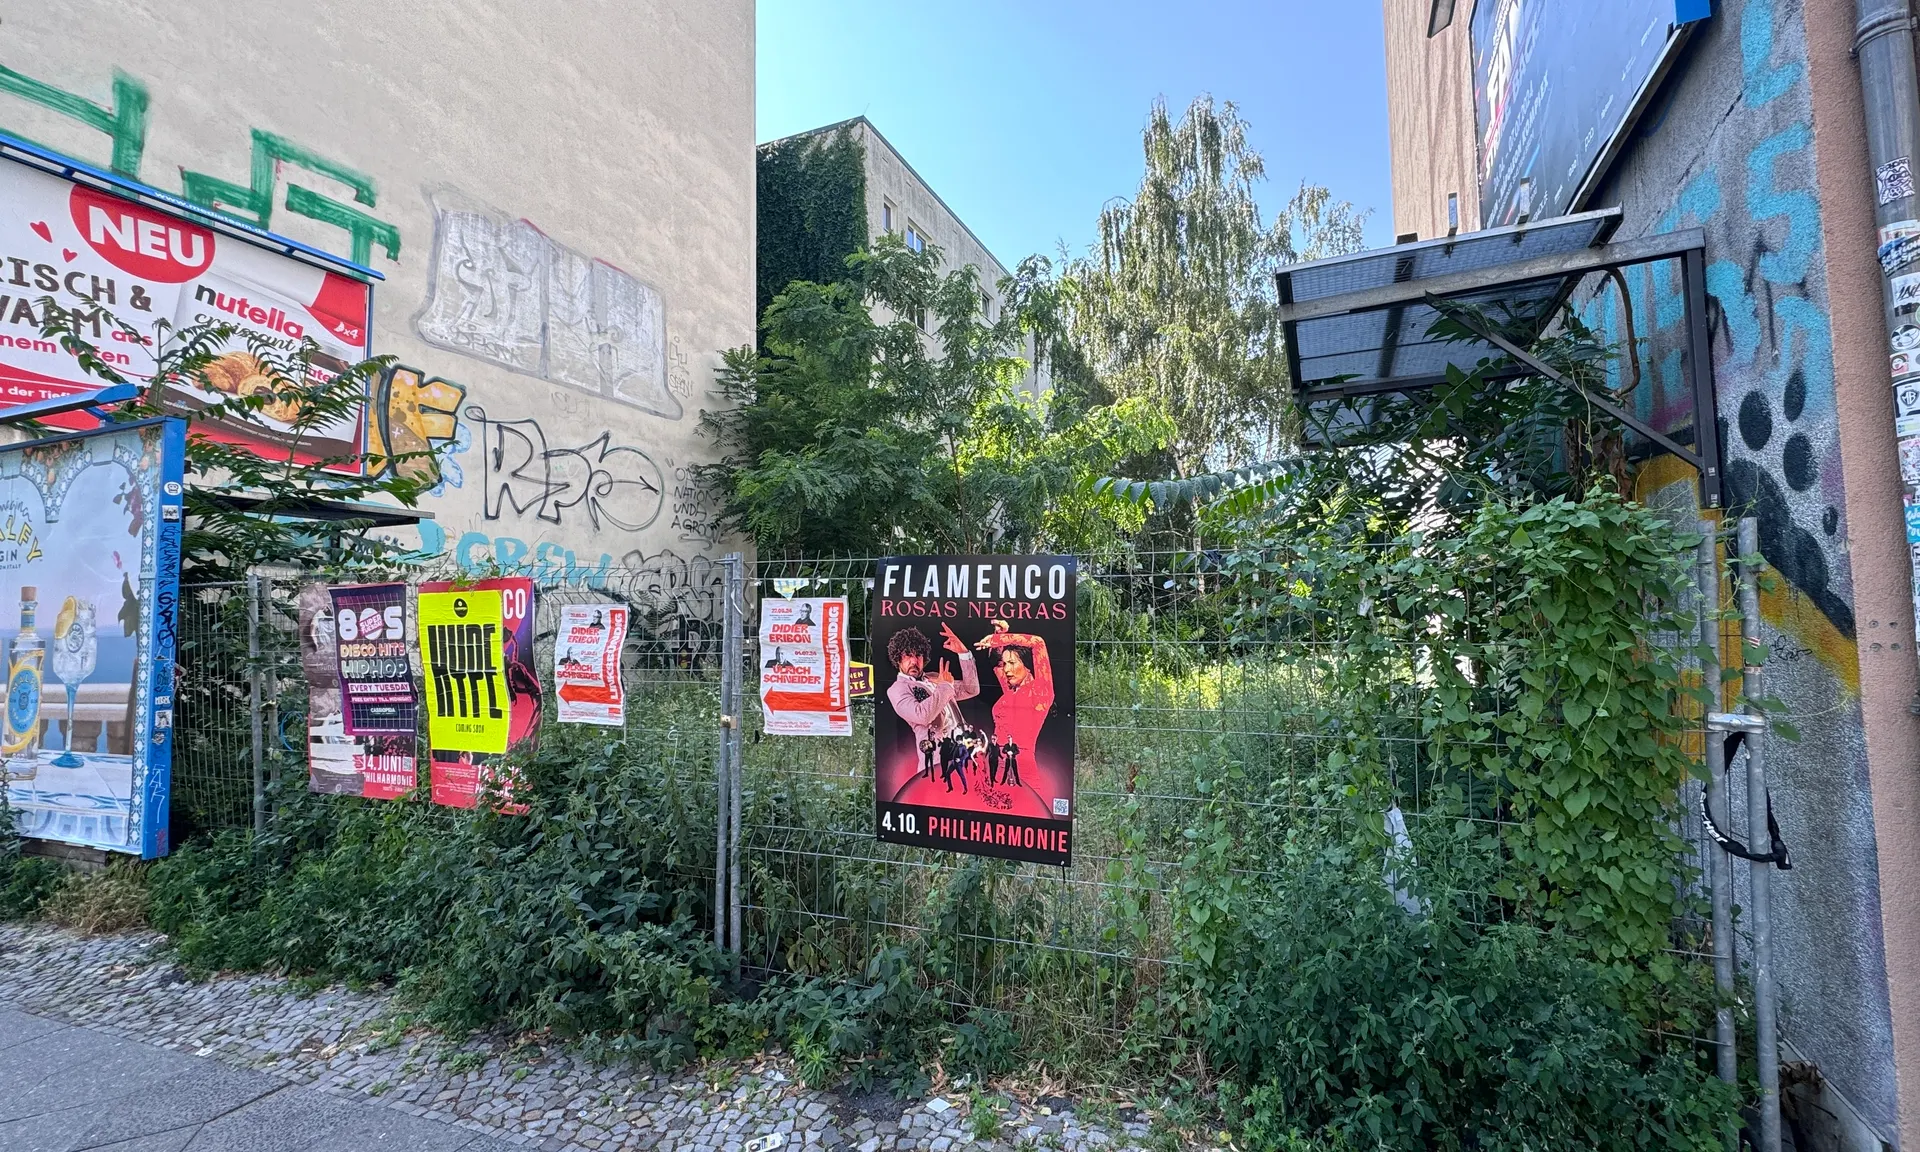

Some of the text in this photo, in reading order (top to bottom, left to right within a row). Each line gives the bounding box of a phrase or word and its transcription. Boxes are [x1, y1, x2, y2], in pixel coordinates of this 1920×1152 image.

[1512, 9, 1541, 105] BACK
[154, 191, 269, 236] www.mediateam.de
[89, 205, 204, 267] NEU
[0, 256, 152, 312] ISCH &
[195, 284, 304, 340] nutella
[8, 386, 35, 397] der
[674, 486, 717, 507] NATION
[456, 531, 613, 588] CREW
[883, 564, 1066, 600] FLAMENCO
[880, 600, 1067, 620] ROSAS NEGRAS
[768, 633, 812, 644] ERIBON
[771, 623, 809, 634] DIDIER
[340, 642, 405, 657] DISCO HITS
[341, 659, 408, 679] HIPHOP
[556, 670, 601, 680] SCHNEIDER
[350, 683, 409, 692] EVERY TUESDAY
[763, 674, 821, 685] SCHNEIDER
[882, 811, 1069, 853] 4.10. PHILHARMONIE
